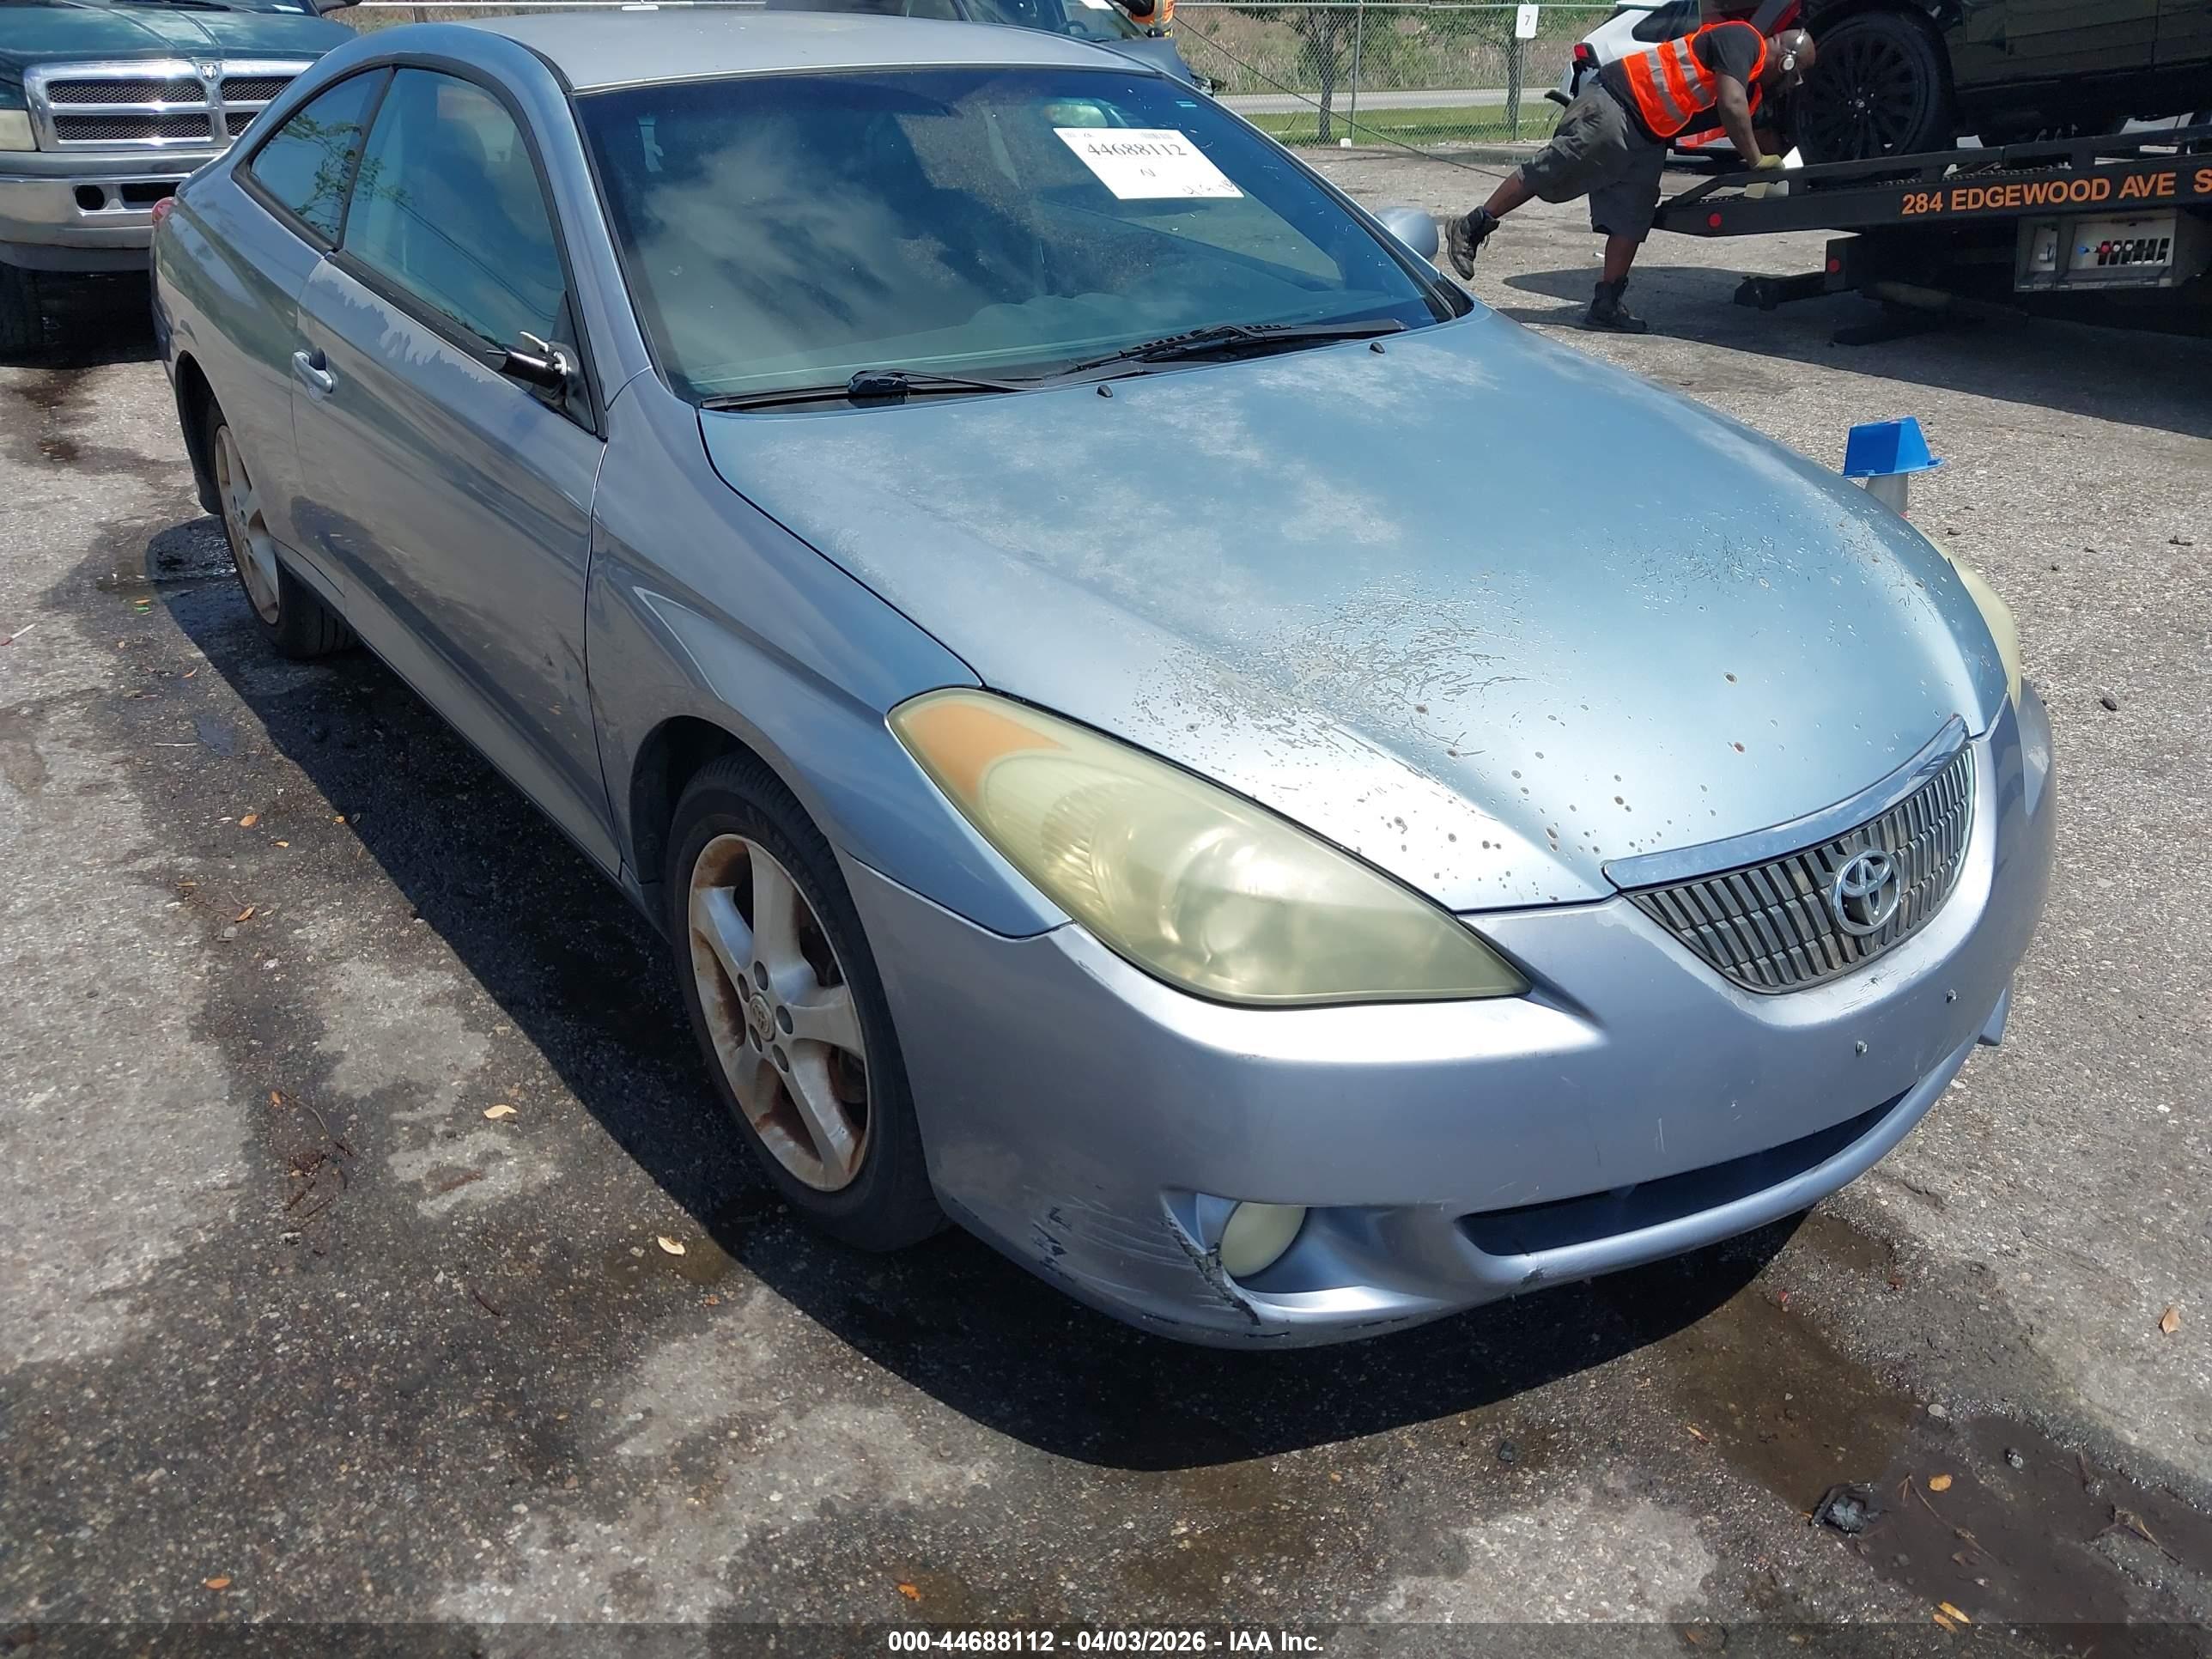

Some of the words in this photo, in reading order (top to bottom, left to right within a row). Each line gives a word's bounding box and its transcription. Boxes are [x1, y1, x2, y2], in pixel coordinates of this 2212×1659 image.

[1525, 14, 1531, 26] 7
[1087, 143, 1188, 156] 44688112
[1901, 191, 1944, 215] 284
[1950, 178, 2112, 211] EDGEWOOD
[2118, 173, 2177, 199] AVE
